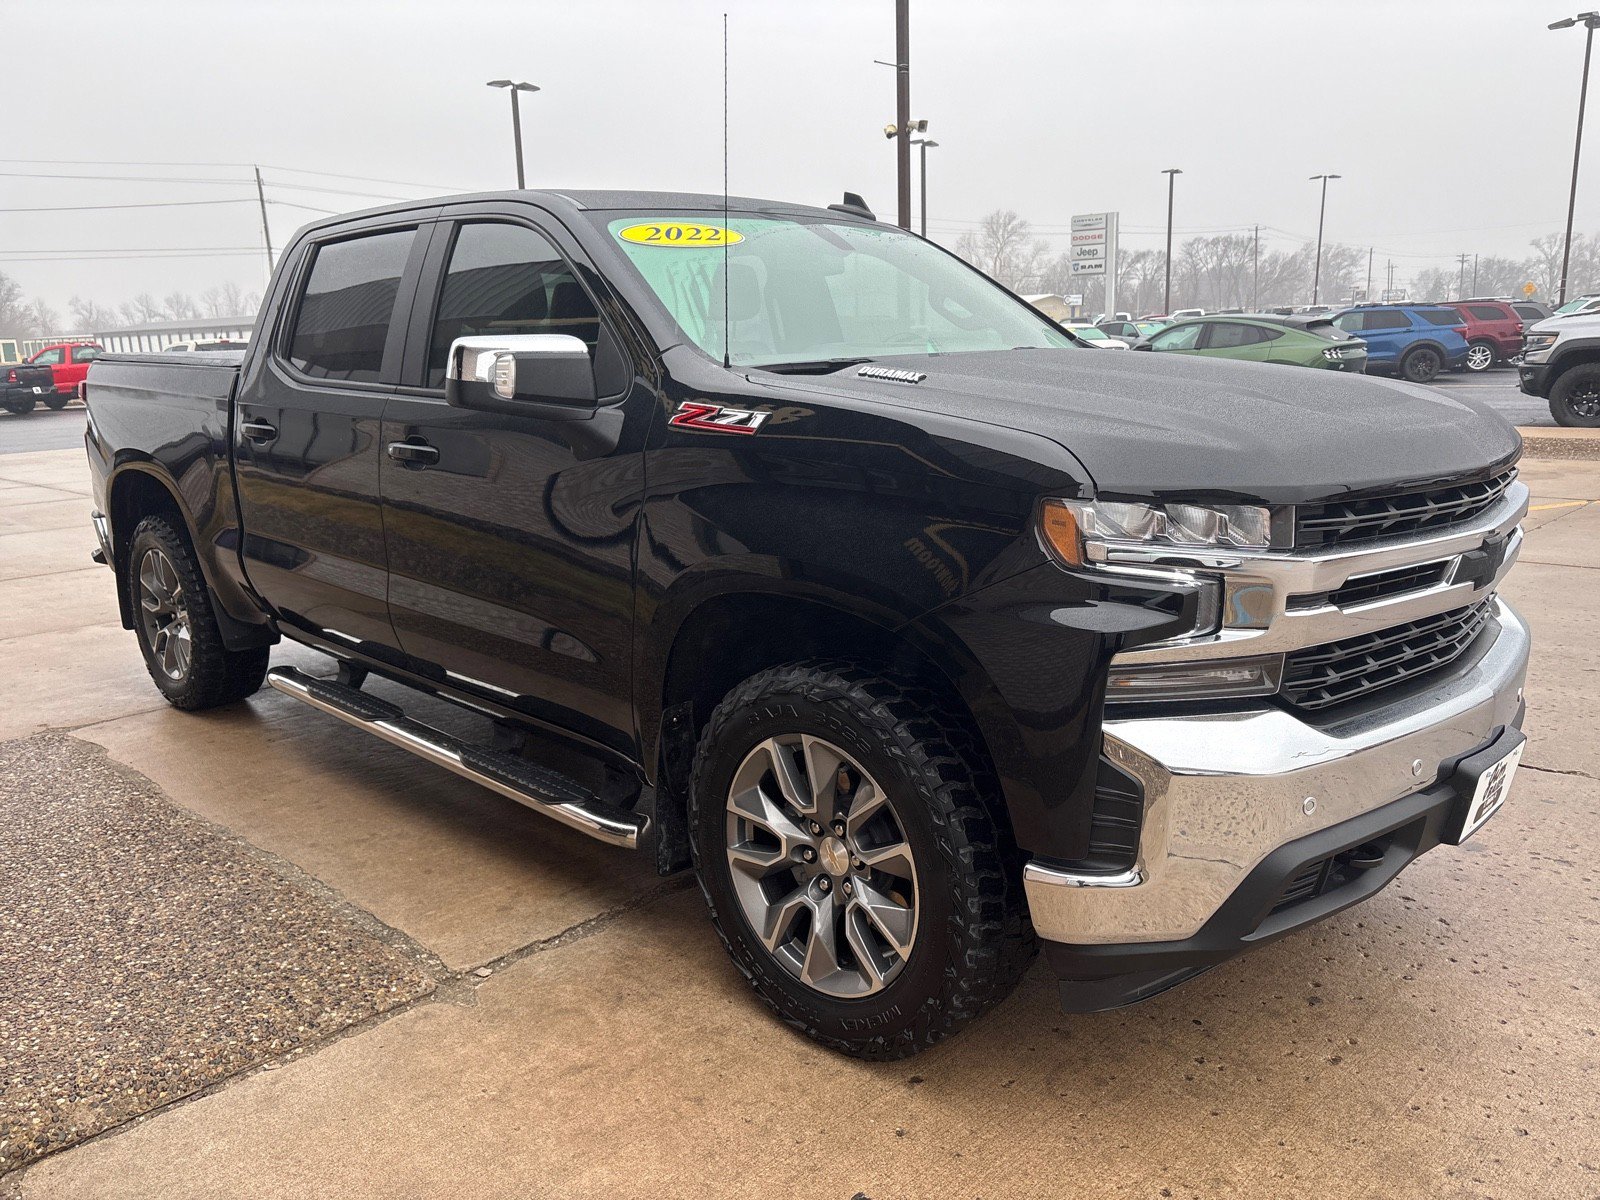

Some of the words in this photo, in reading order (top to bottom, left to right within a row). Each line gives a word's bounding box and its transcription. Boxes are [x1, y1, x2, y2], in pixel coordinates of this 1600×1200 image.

[645, 227, 721, 241] 2022
[1076, 247, 1099, 257] Jeep
[857, 366, 927, 384] DURAMAX
[668, 401, 773, 436] Z71
